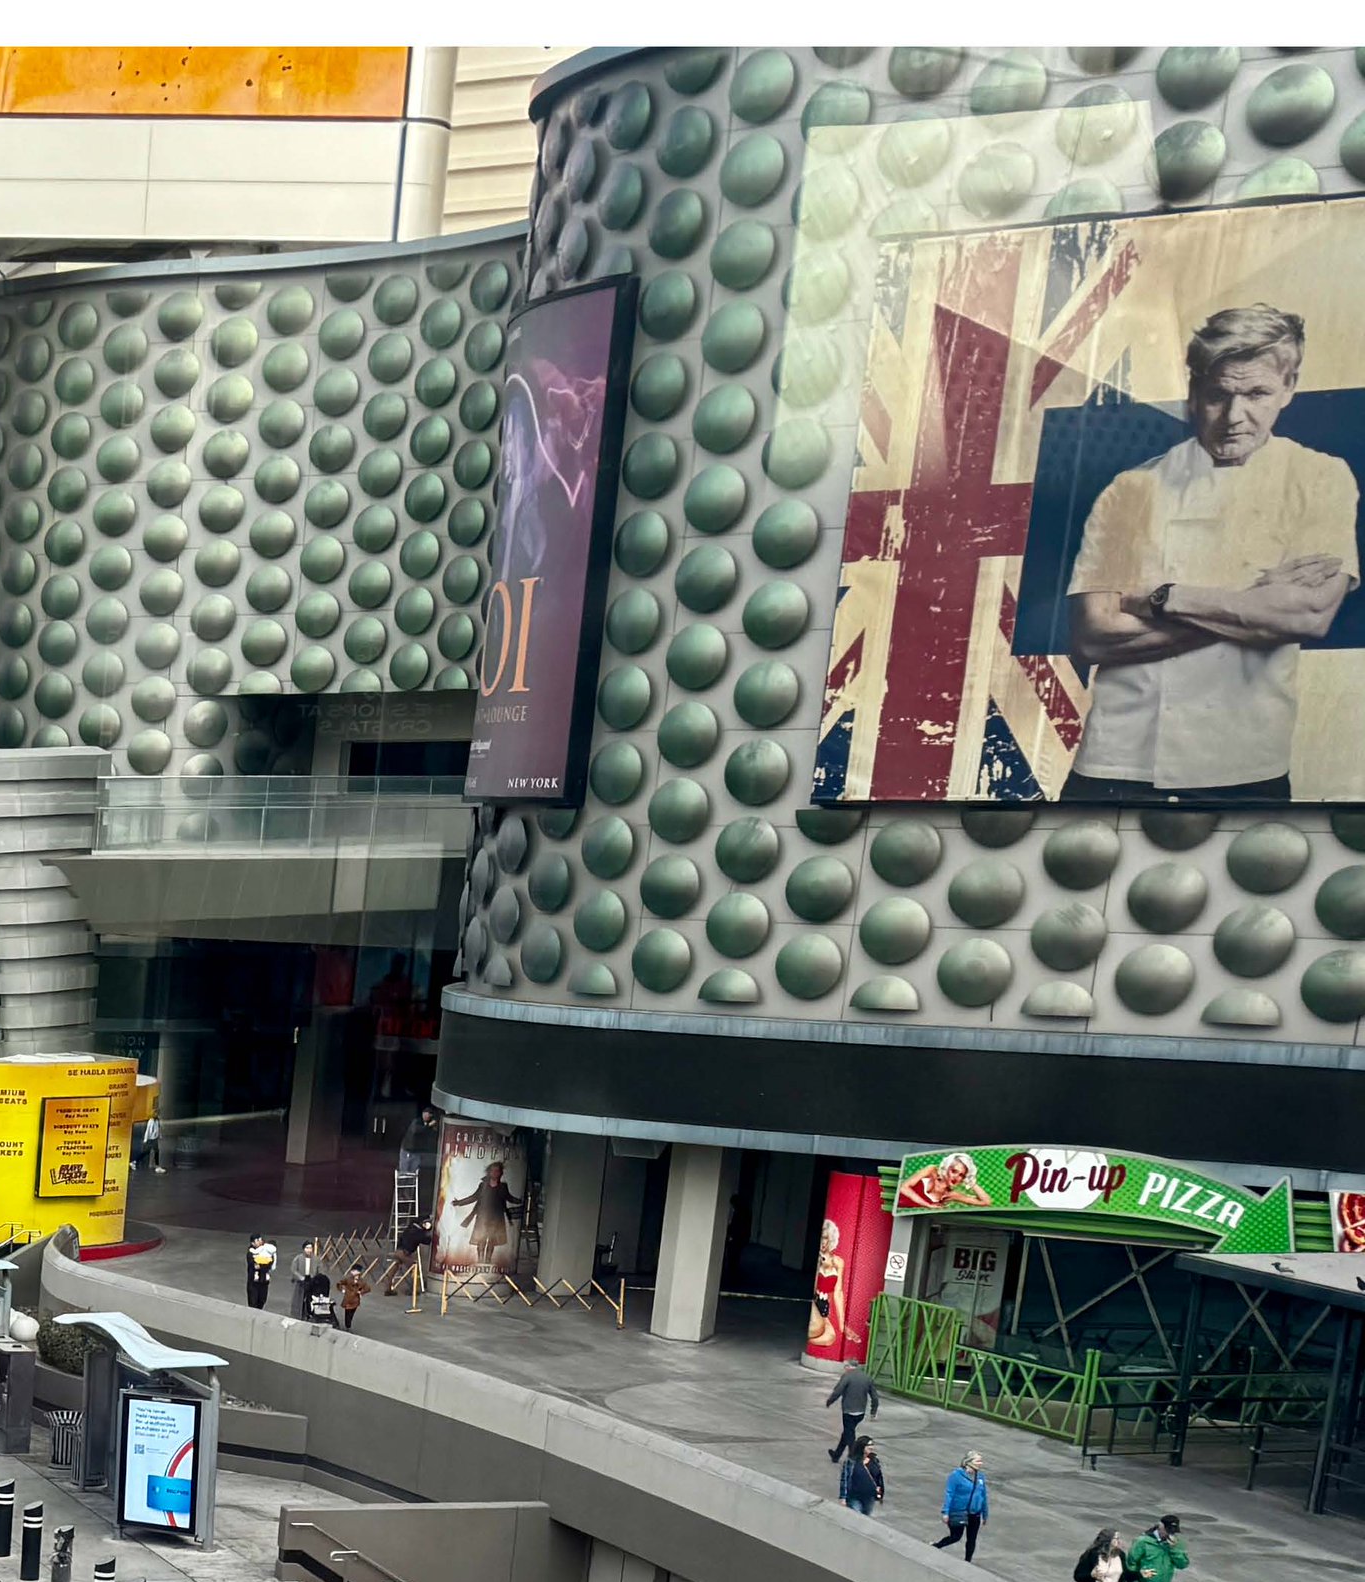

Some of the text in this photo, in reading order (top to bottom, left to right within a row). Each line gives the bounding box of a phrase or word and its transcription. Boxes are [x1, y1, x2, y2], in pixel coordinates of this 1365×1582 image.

[507, 777, 559, 789] NEW YORK
[456, 1132, 491, 1143] CRISS
[1005, 1152, 1245, 1229] Pin-up PIZZA
[953, 1247, 997, 1271] BIG
